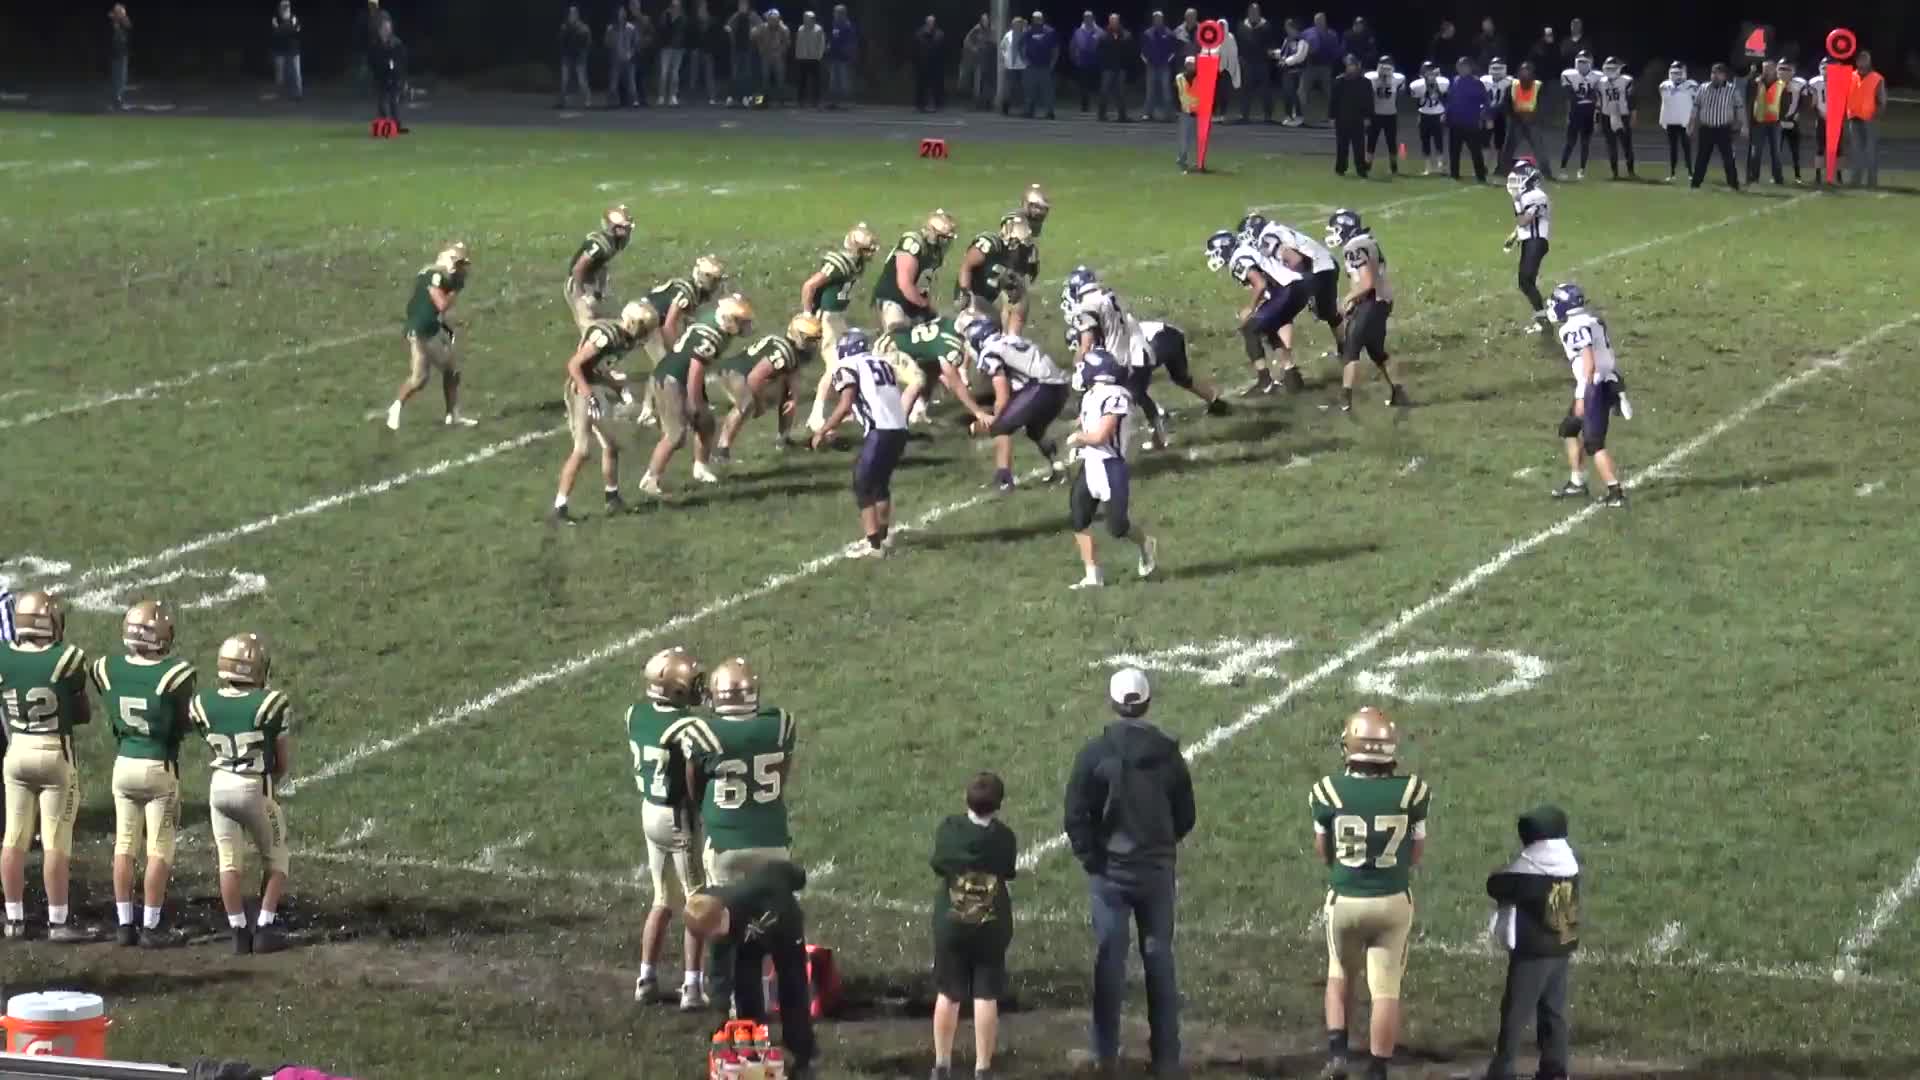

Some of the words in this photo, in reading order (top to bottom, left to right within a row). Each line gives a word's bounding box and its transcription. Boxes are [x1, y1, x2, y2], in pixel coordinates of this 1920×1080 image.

[374, 120, 392, 138] 10
[921, 141, 944, 158] 20
[865, 359, 897, 386] 50
[2, 687, 59, 732] 12
[119, 696, 150, 735] 5
[713, 752, 785, 808] 65
[1334, 814, 1409, 868] 87
